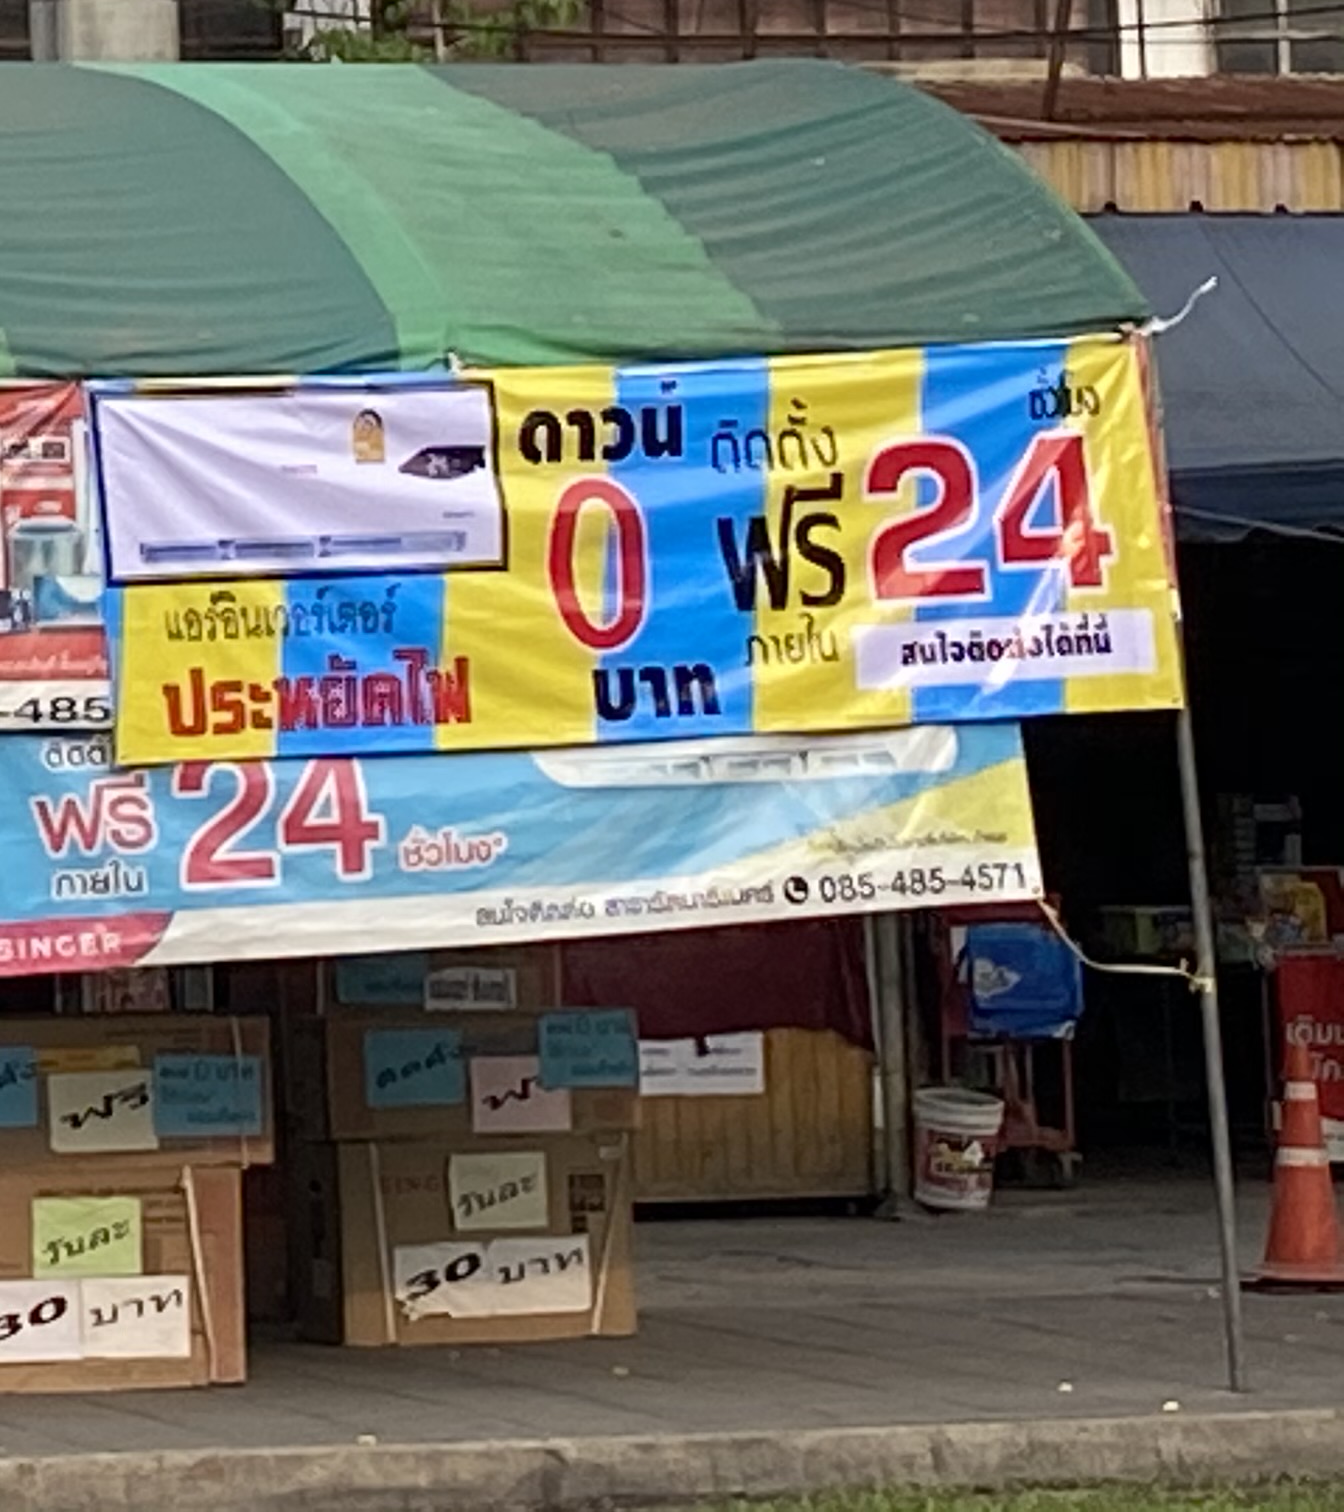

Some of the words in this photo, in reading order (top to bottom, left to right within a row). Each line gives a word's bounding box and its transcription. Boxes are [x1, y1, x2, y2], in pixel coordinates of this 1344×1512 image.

[518, 379, 684, 465] ดาวน์
[711, 398, 838, 473] ติดตั้ง
[716, 472, 847, 612] ฟรี
[864, 428, 1115, 607] 24
[548, 475, 650, 652] 0
[744, 612, 841, 668] ภายใน
[161, 647, 473, 738] ประหยัดไฟ
[592, 656, 722, 723] บาท
[33, 772, 154, 854] ฟรี
[174, 759, 381, 886] 24
[54, 861, 144, 897] ภายใน
[818, 862, 1027, 904] 085-485-4571
[456, 1172, 539, 1218] วันละ
[40, 1218, 132, 1266] วันละ
[405, 1251, 481, 1302] 30
[497, 1246, 585, 1286] บาท
[88, 1287, 185, 1328] บาท
